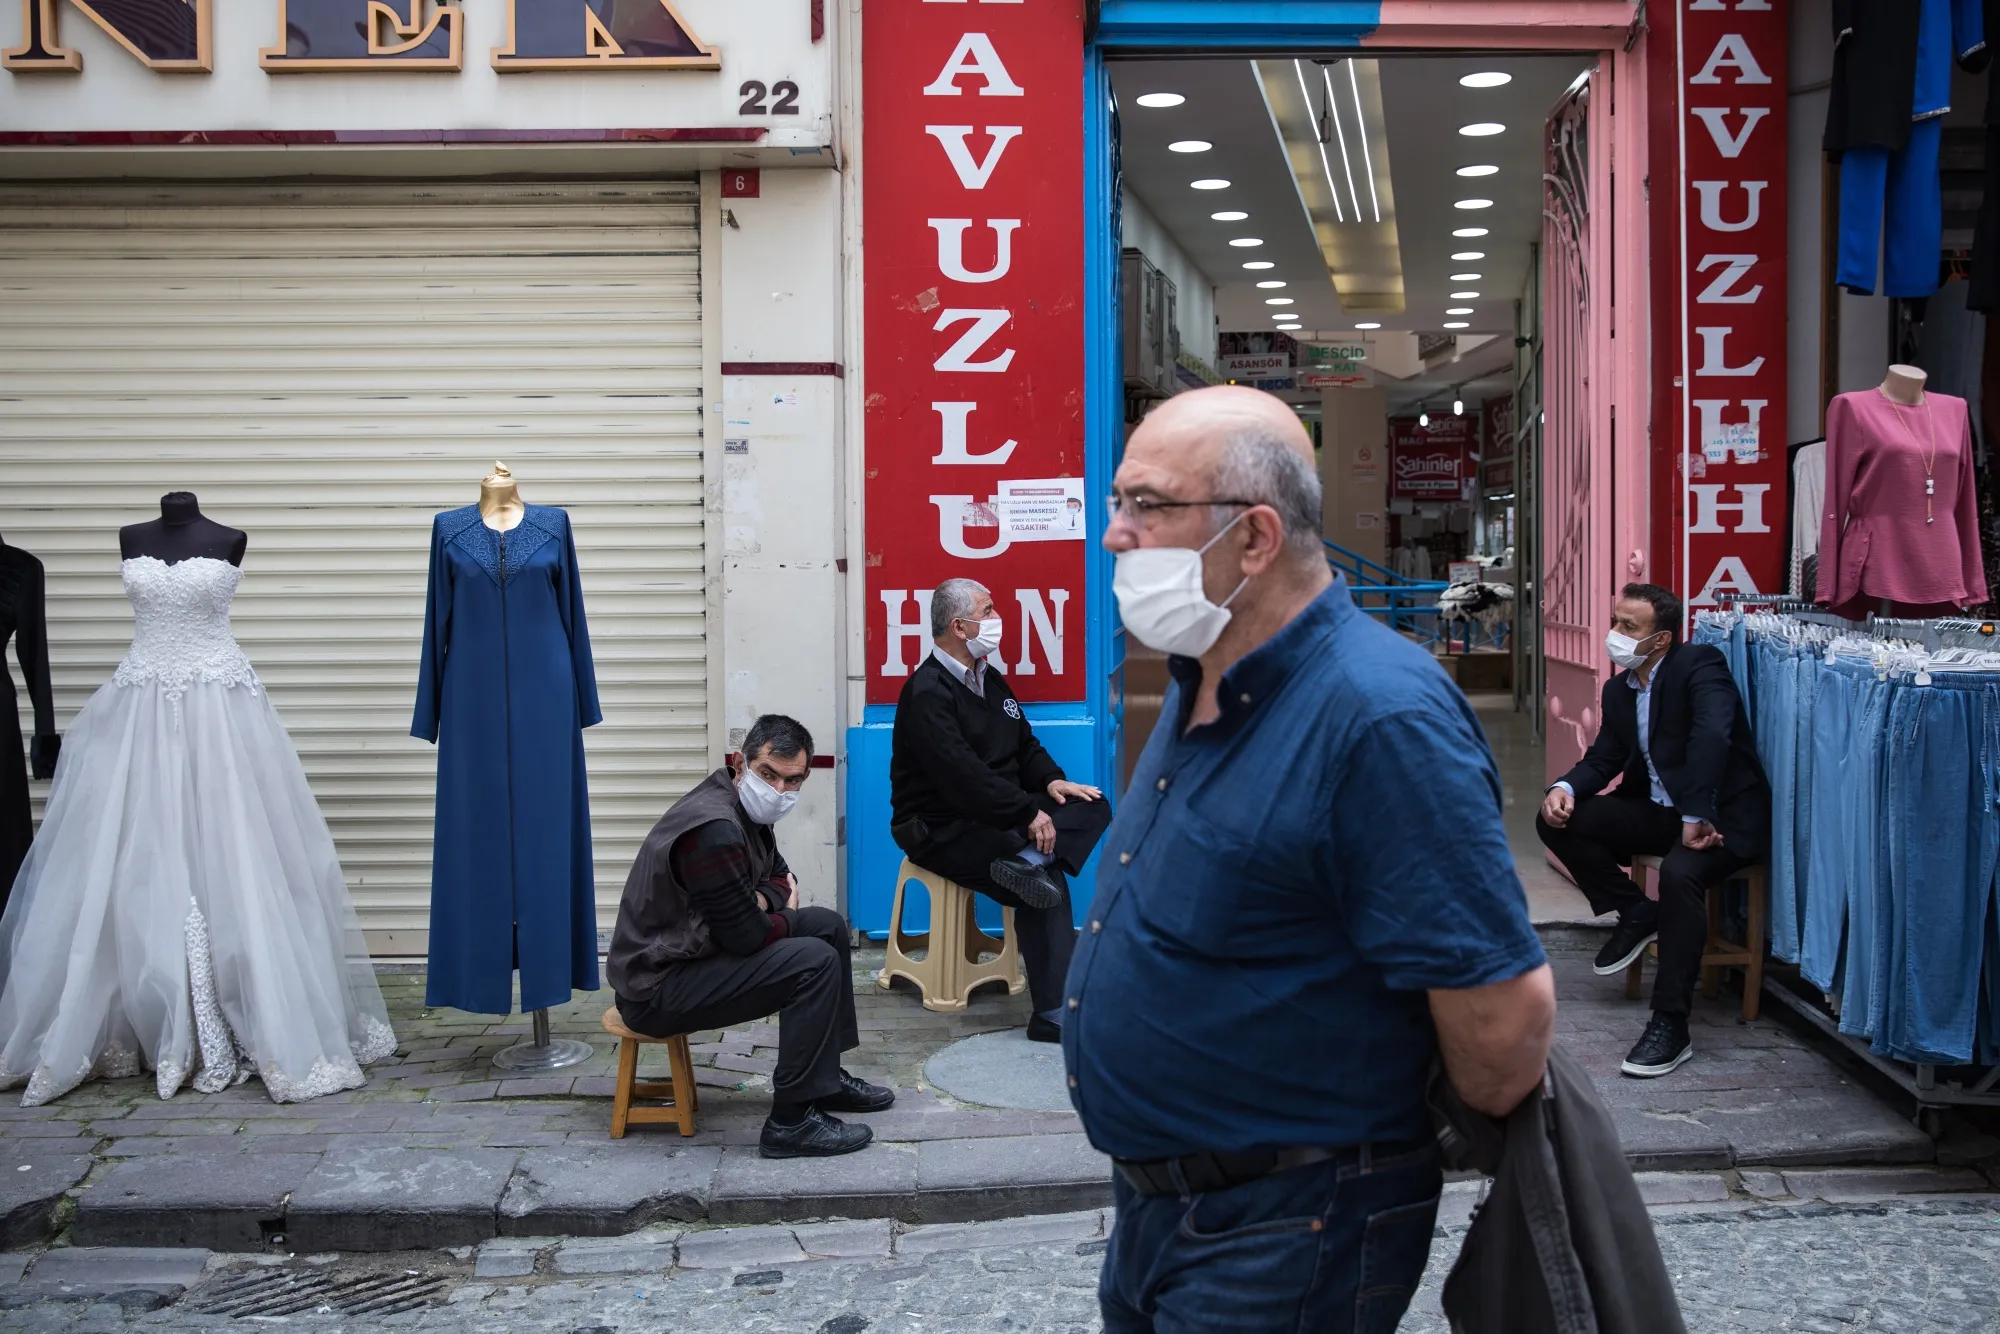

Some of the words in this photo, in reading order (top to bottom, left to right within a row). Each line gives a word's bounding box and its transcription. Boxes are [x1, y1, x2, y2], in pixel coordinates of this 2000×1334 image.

[739, 81, 799, 115] 22
[735, 176, 745, 190] 6
[922, 0, 1024, 559] AVUZLU
[1229, 358, 1283, 369] ASANSÖR
[880, 588, 1070, 676] HN
